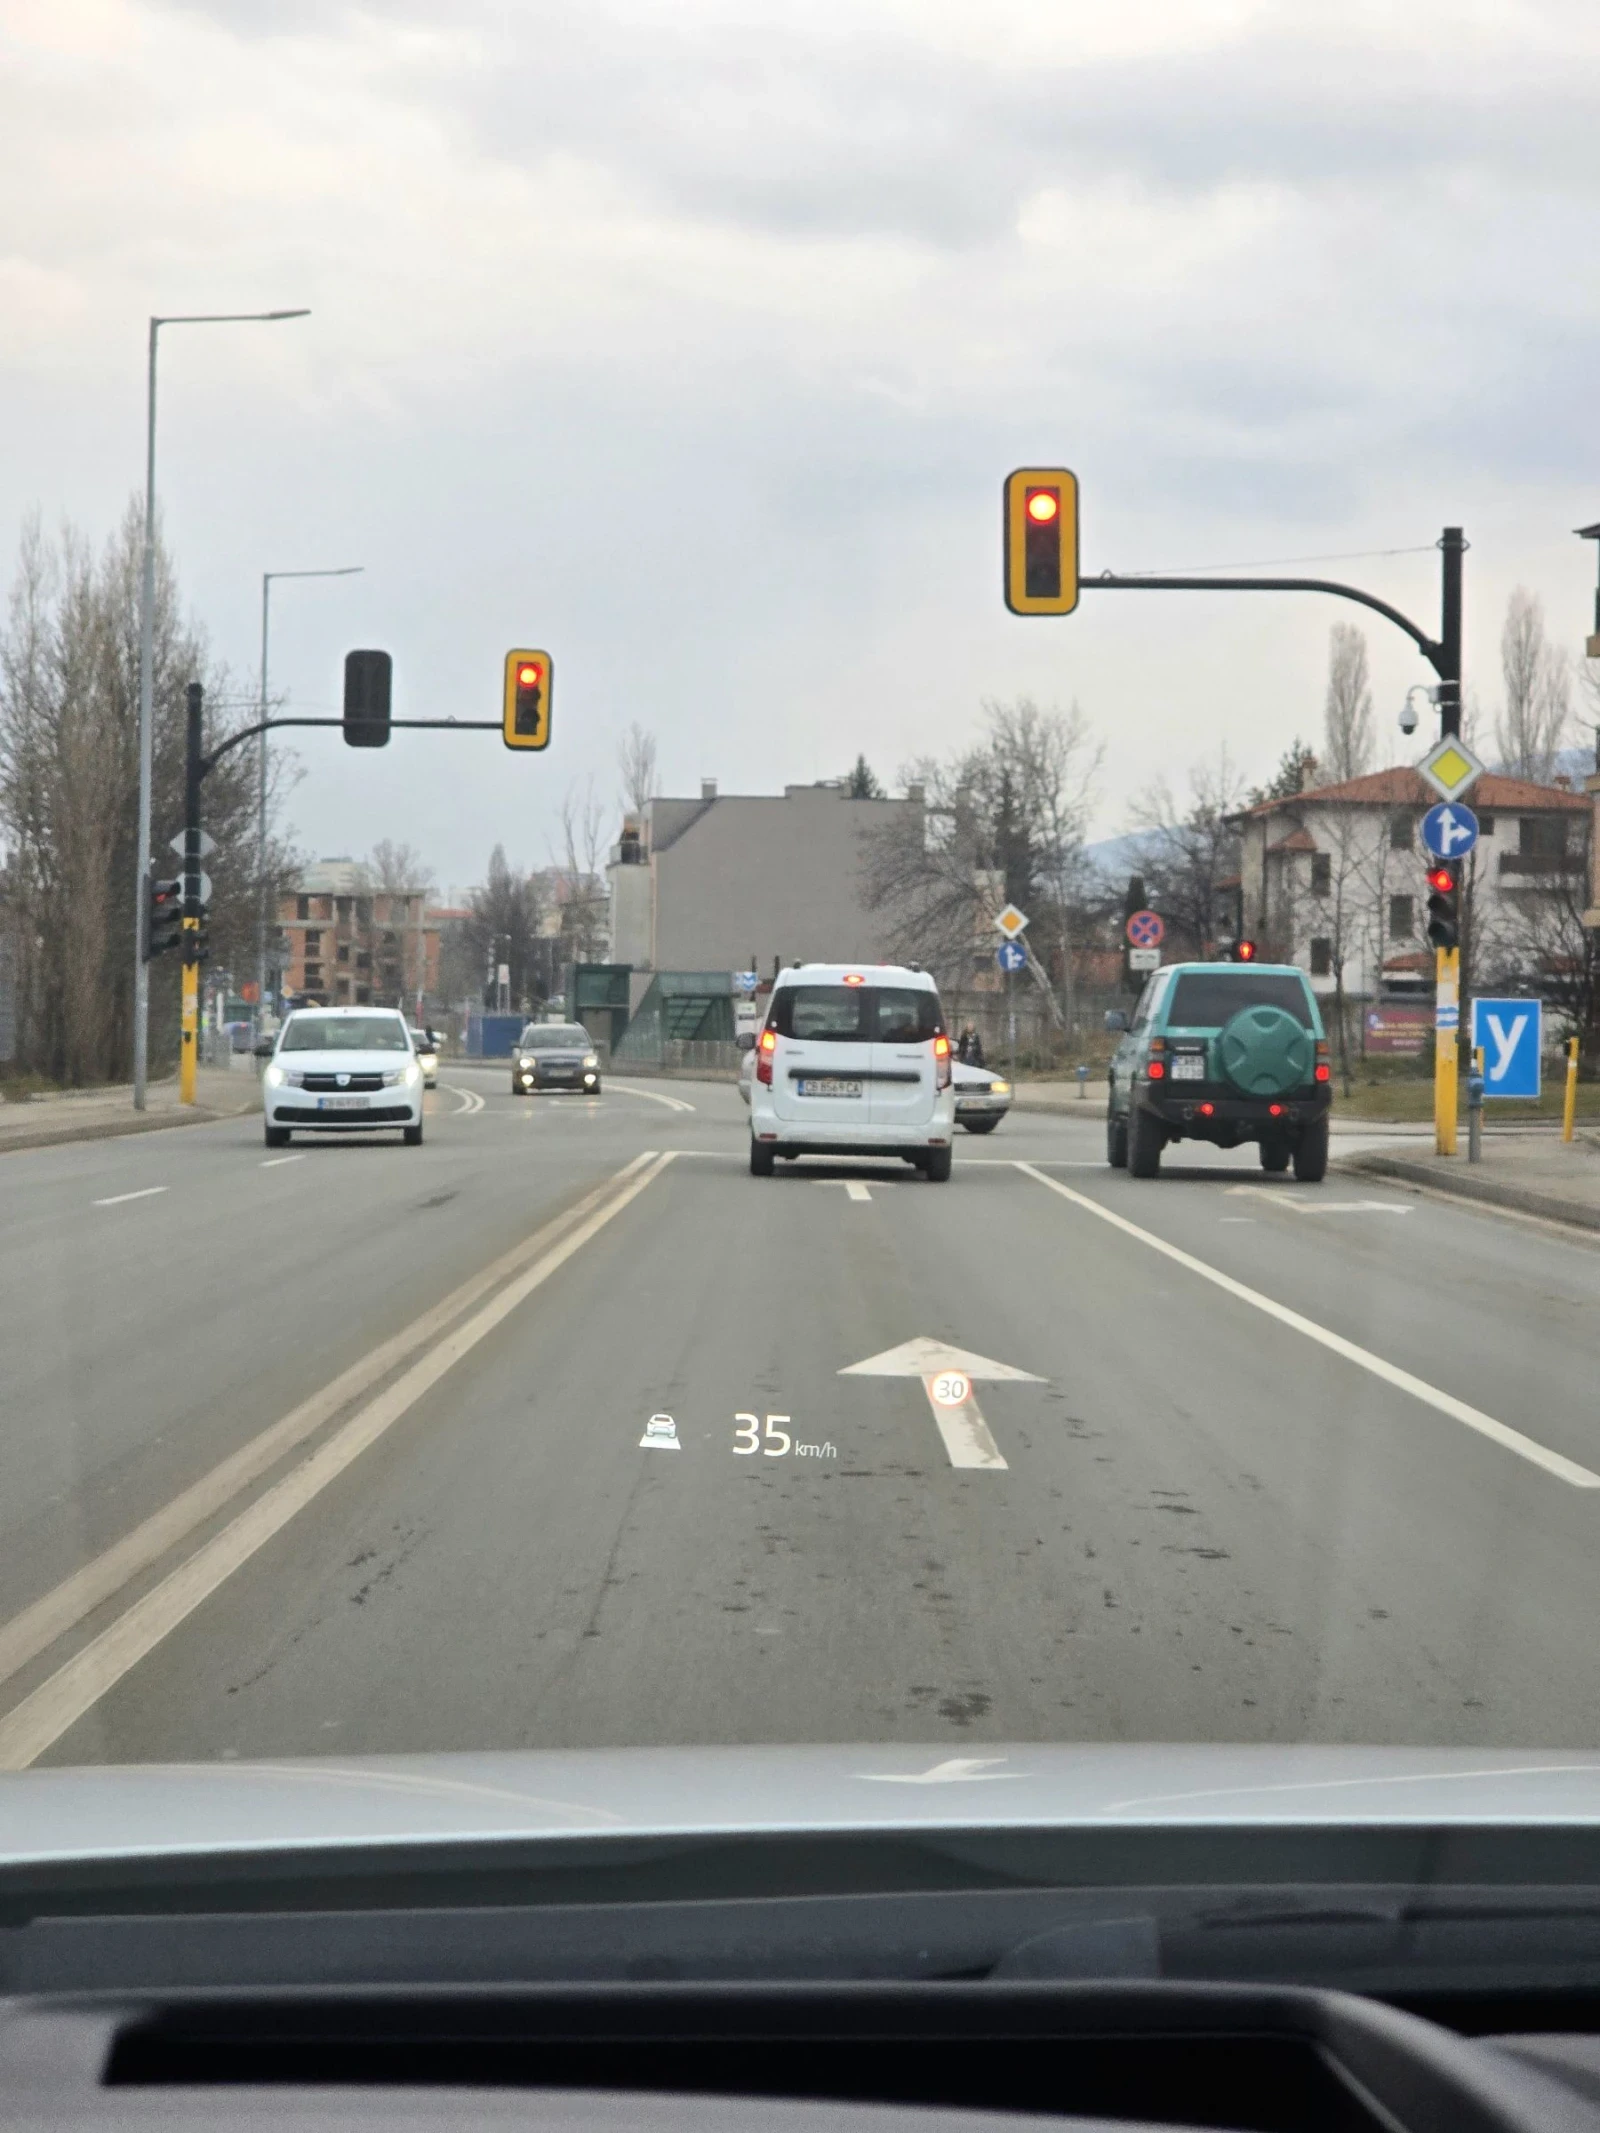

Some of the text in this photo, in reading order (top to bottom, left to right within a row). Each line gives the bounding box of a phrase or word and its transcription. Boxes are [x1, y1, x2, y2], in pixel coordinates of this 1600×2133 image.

[938, 1380, 965, 1399] 30
[732, 1412, 837, 1458] 35 km/h
